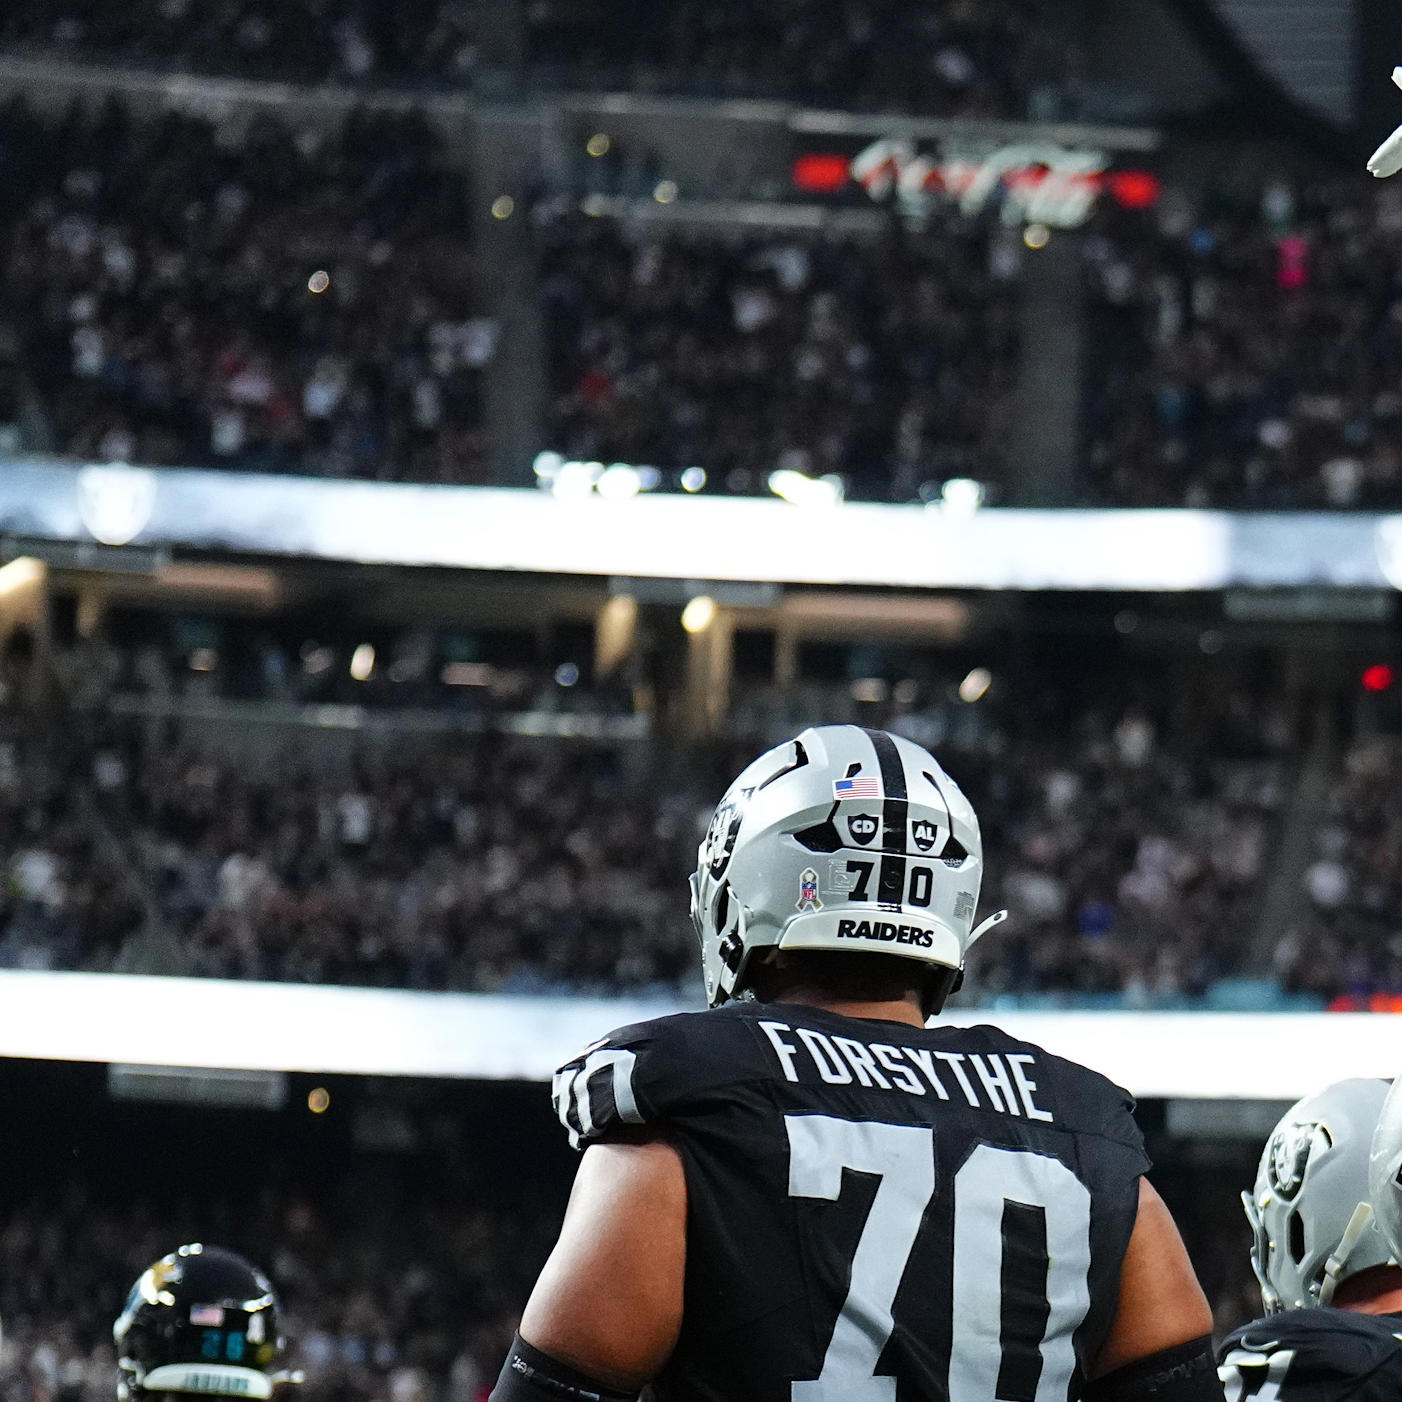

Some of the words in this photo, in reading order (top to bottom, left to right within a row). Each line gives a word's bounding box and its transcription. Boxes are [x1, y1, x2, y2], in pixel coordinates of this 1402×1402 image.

[851, 820, 875, 834] CD
[915, 825, 935, 842] AL
[837, 919, 935, 948] RAIDERS
[758, 1021, 1054, 1123] FORSYTHE
